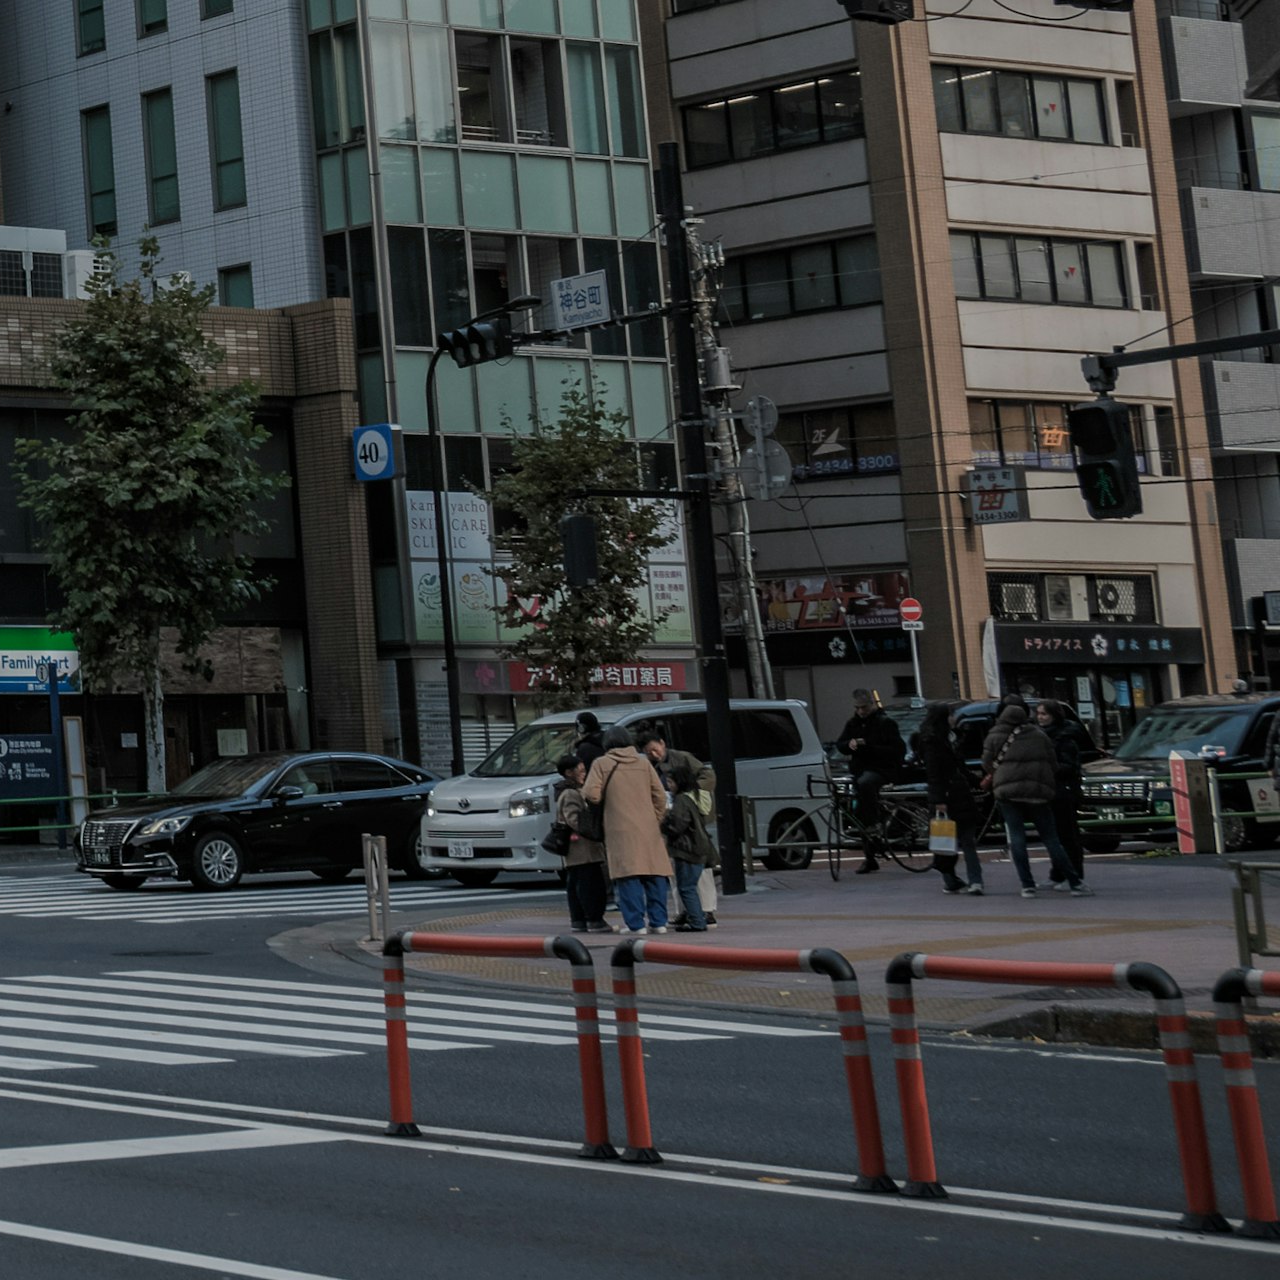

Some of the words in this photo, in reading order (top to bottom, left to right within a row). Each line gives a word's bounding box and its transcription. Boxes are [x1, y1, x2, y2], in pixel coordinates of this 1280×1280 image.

[559, 285, 601, 312] 神谷町
[562, 308, 603, 324] Kamiyacho
[410, 499, 486, 515] kamyacho
[974, 511, 1018, 521] 3434-3300
[451, 519, 487, 532] CARE
[412, 535, 467, 549] CLIIC
[1023, 637, 1083, 651] ドライアイス
